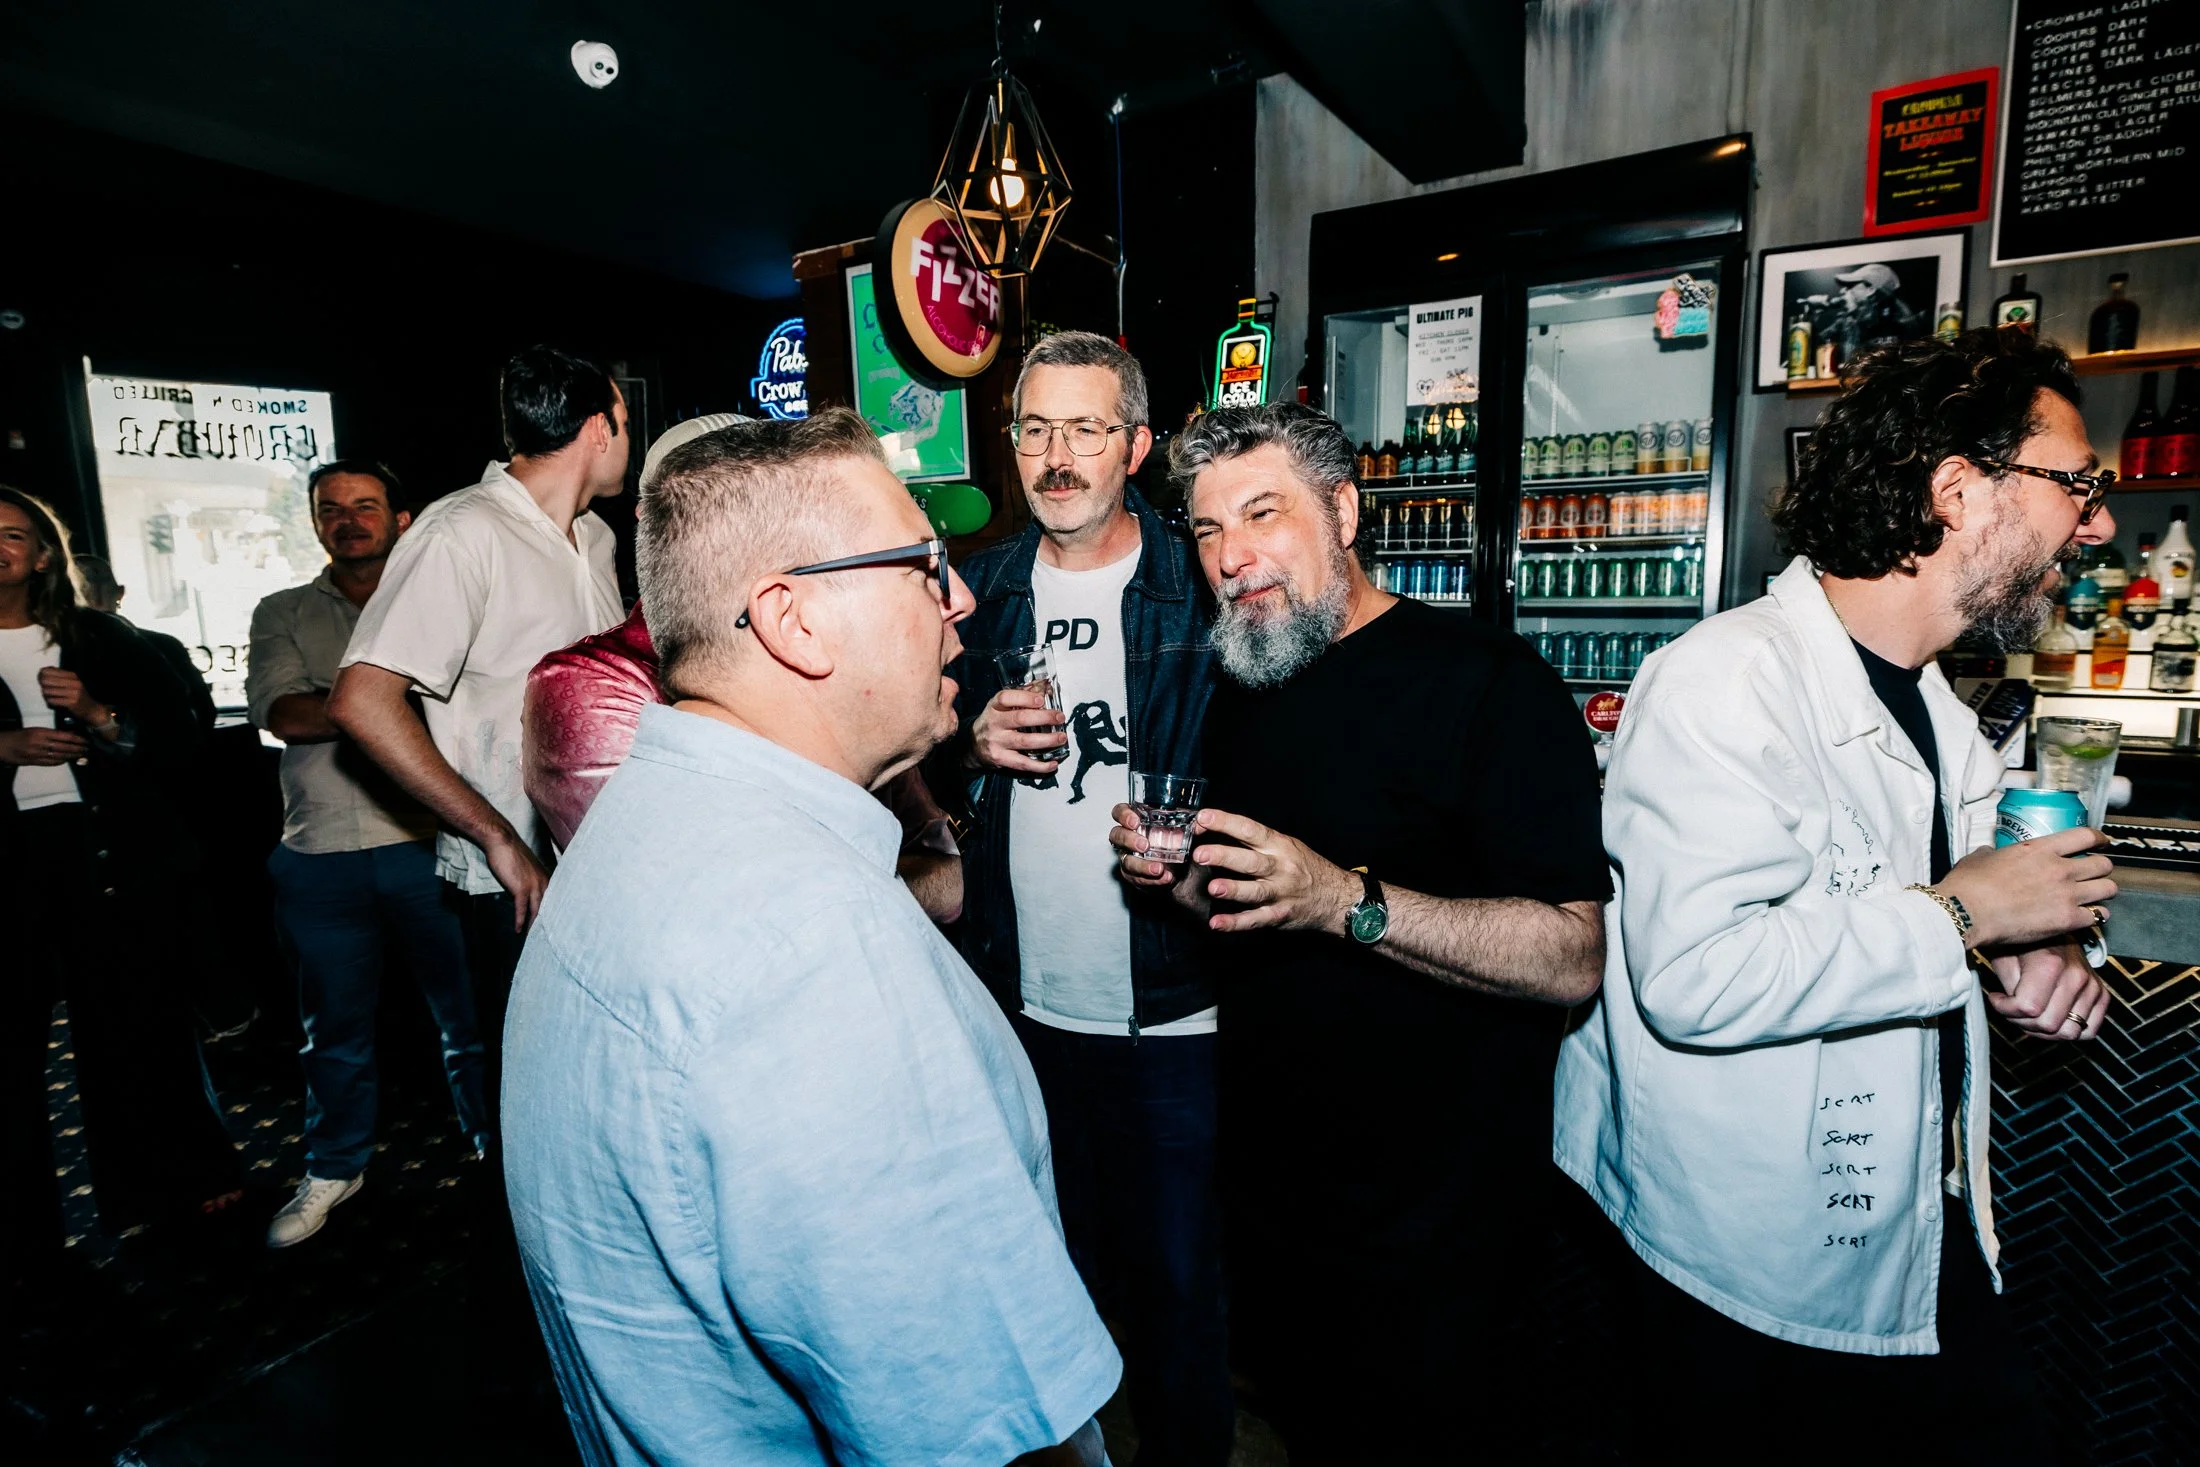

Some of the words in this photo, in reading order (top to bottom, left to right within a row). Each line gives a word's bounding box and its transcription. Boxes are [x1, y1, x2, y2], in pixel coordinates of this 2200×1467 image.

[2108, 16, 2148, 32] DARK
[2107, 28, 2145, 44] PALE
[2175, 82, 2200, 94] BEE
[1884, 106, 1985, 138] TAKEAWAY
[910, 236, 1000, 322] FIZZER
[1416, 308, 1454, 324] ULTIMATE
[1458, 306, 1474, 319] PIG
[1230, 382, 1251, 394] ICE
[1223, 391, 1256, 408] COLD
[1044, 617, 1099, 650] PD
[1824, 1234, 1867, 1248] SCRT
